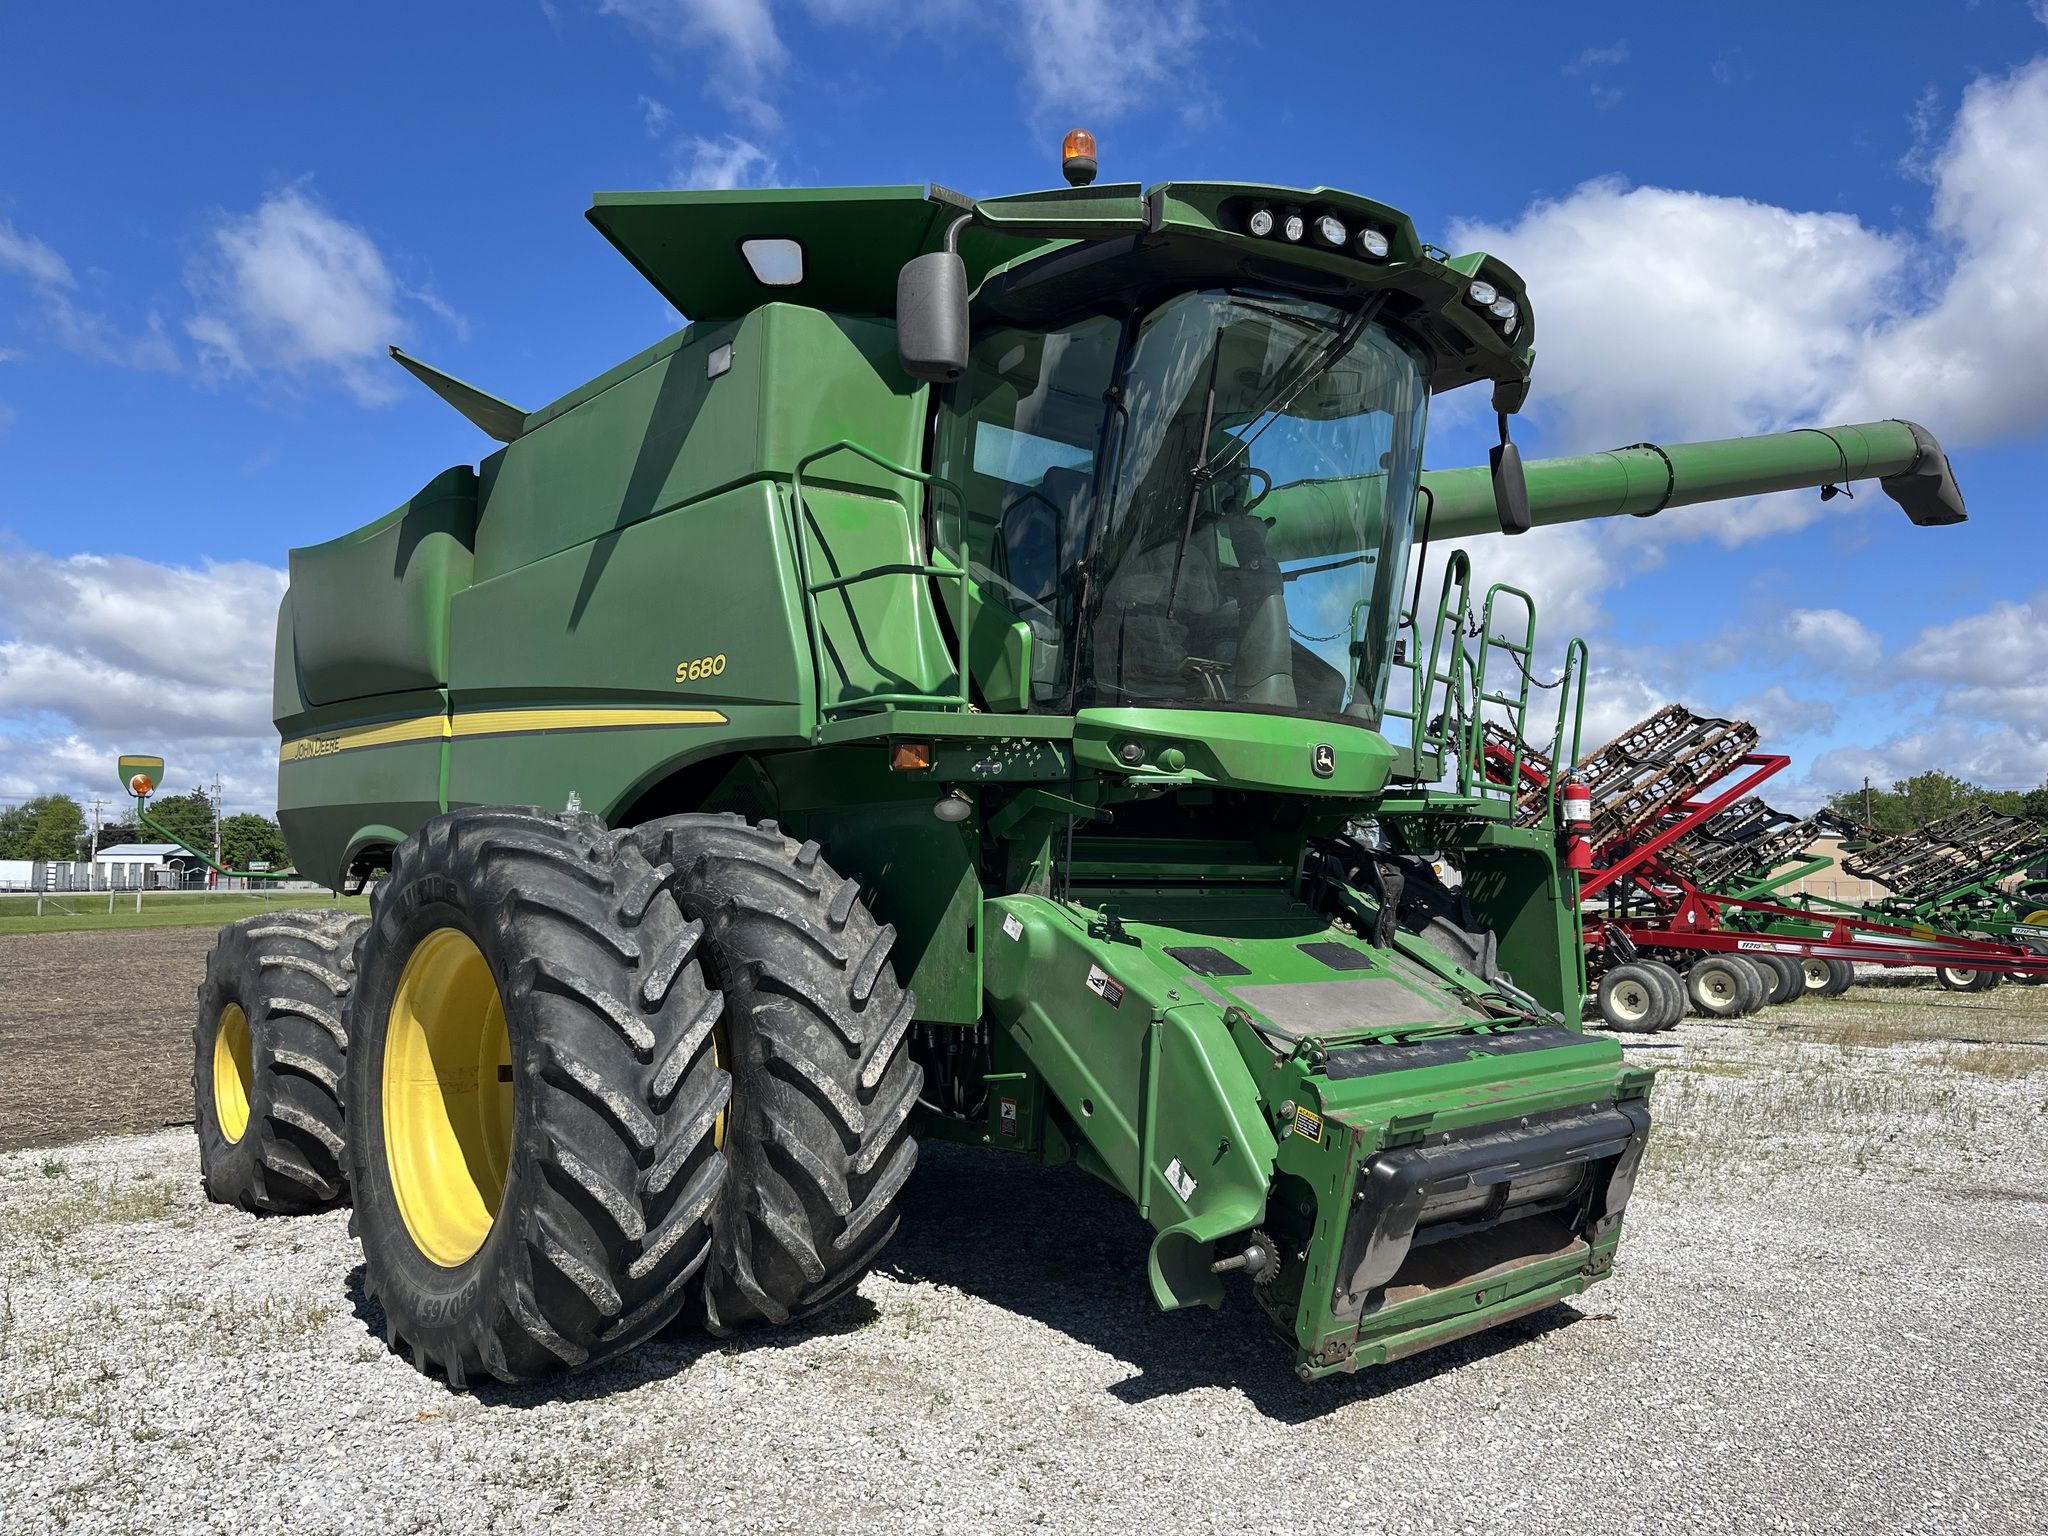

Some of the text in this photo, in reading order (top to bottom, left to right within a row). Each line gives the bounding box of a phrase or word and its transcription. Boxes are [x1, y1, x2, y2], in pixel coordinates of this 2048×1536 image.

[675, 653, 727, 684] S680
[295, 737, 341, 759] JOHN DEERE
